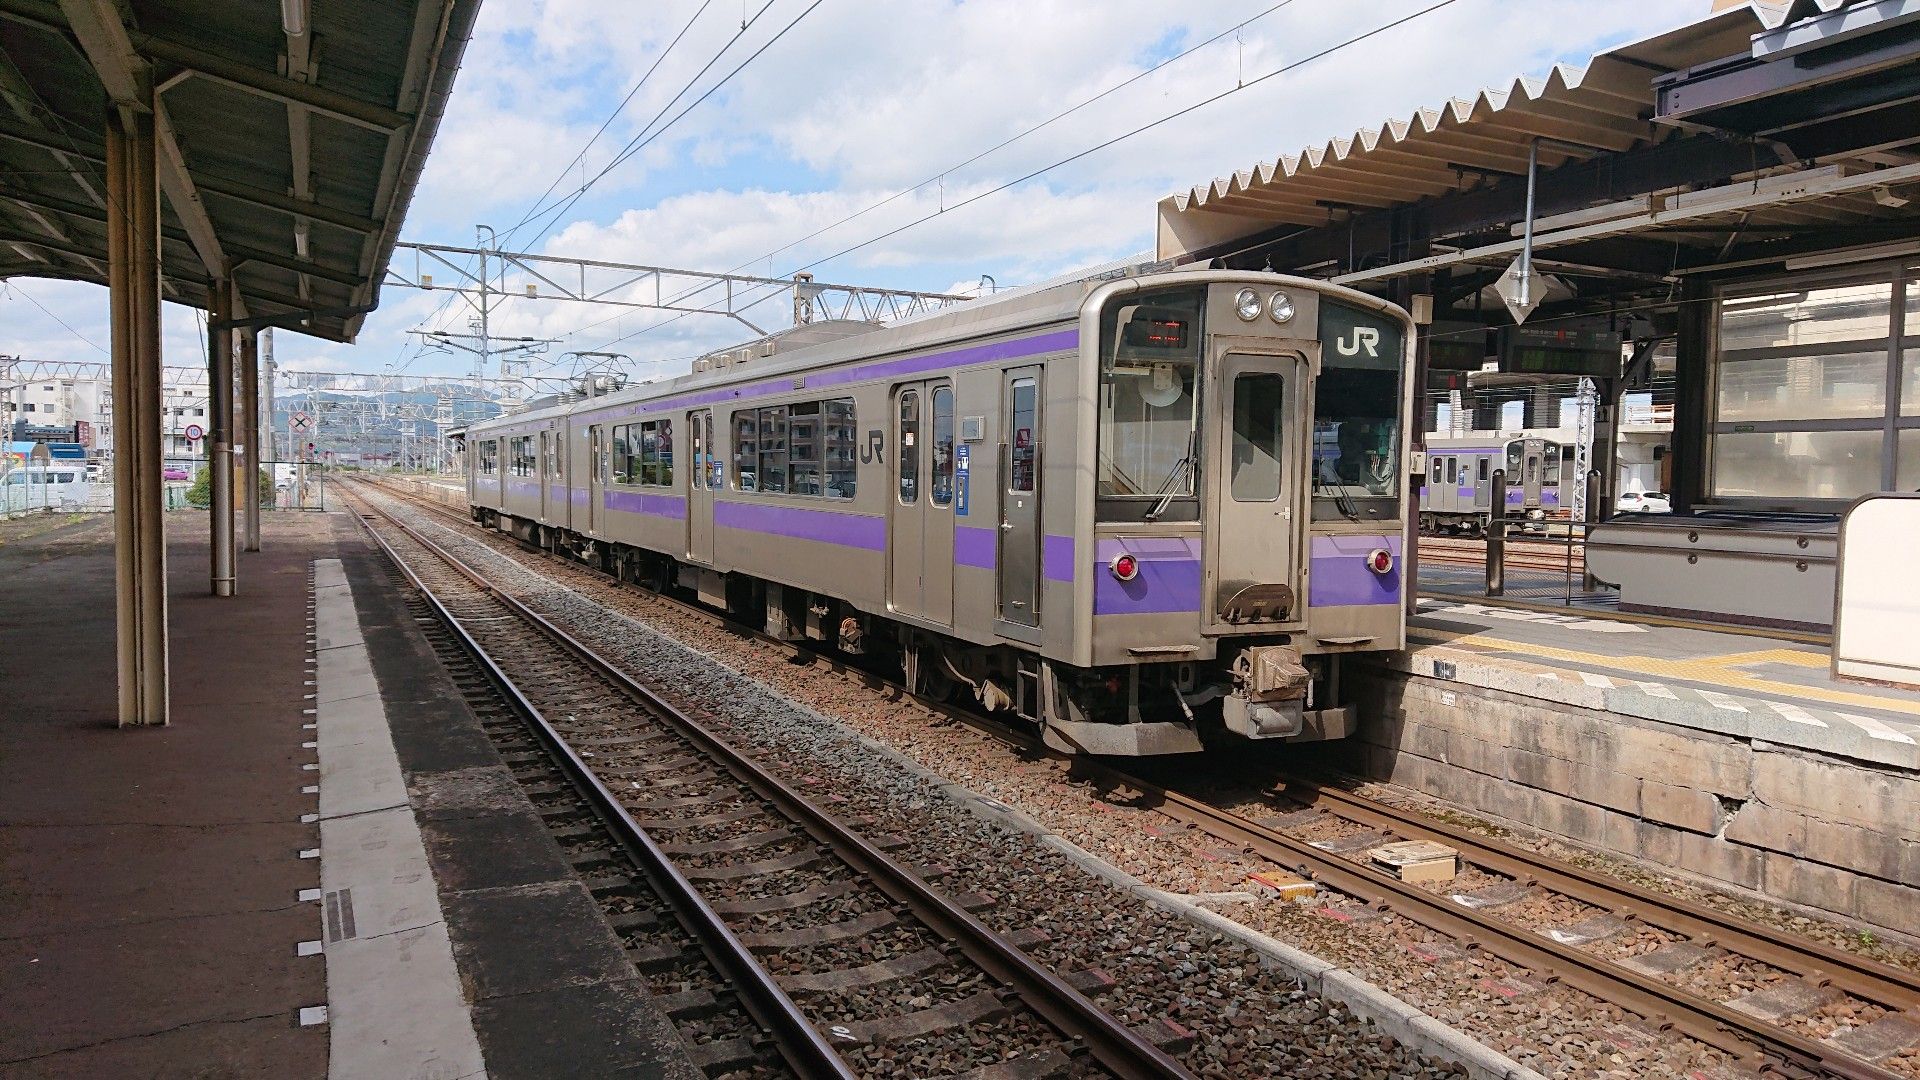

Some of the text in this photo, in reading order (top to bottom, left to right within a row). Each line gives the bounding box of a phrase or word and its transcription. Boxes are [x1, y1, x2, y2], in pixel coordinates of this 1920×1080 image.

[1337, 326, 1379, 357] JR
[190, 428, 199, 436] 10
[860, 430, 883, 464] JR
